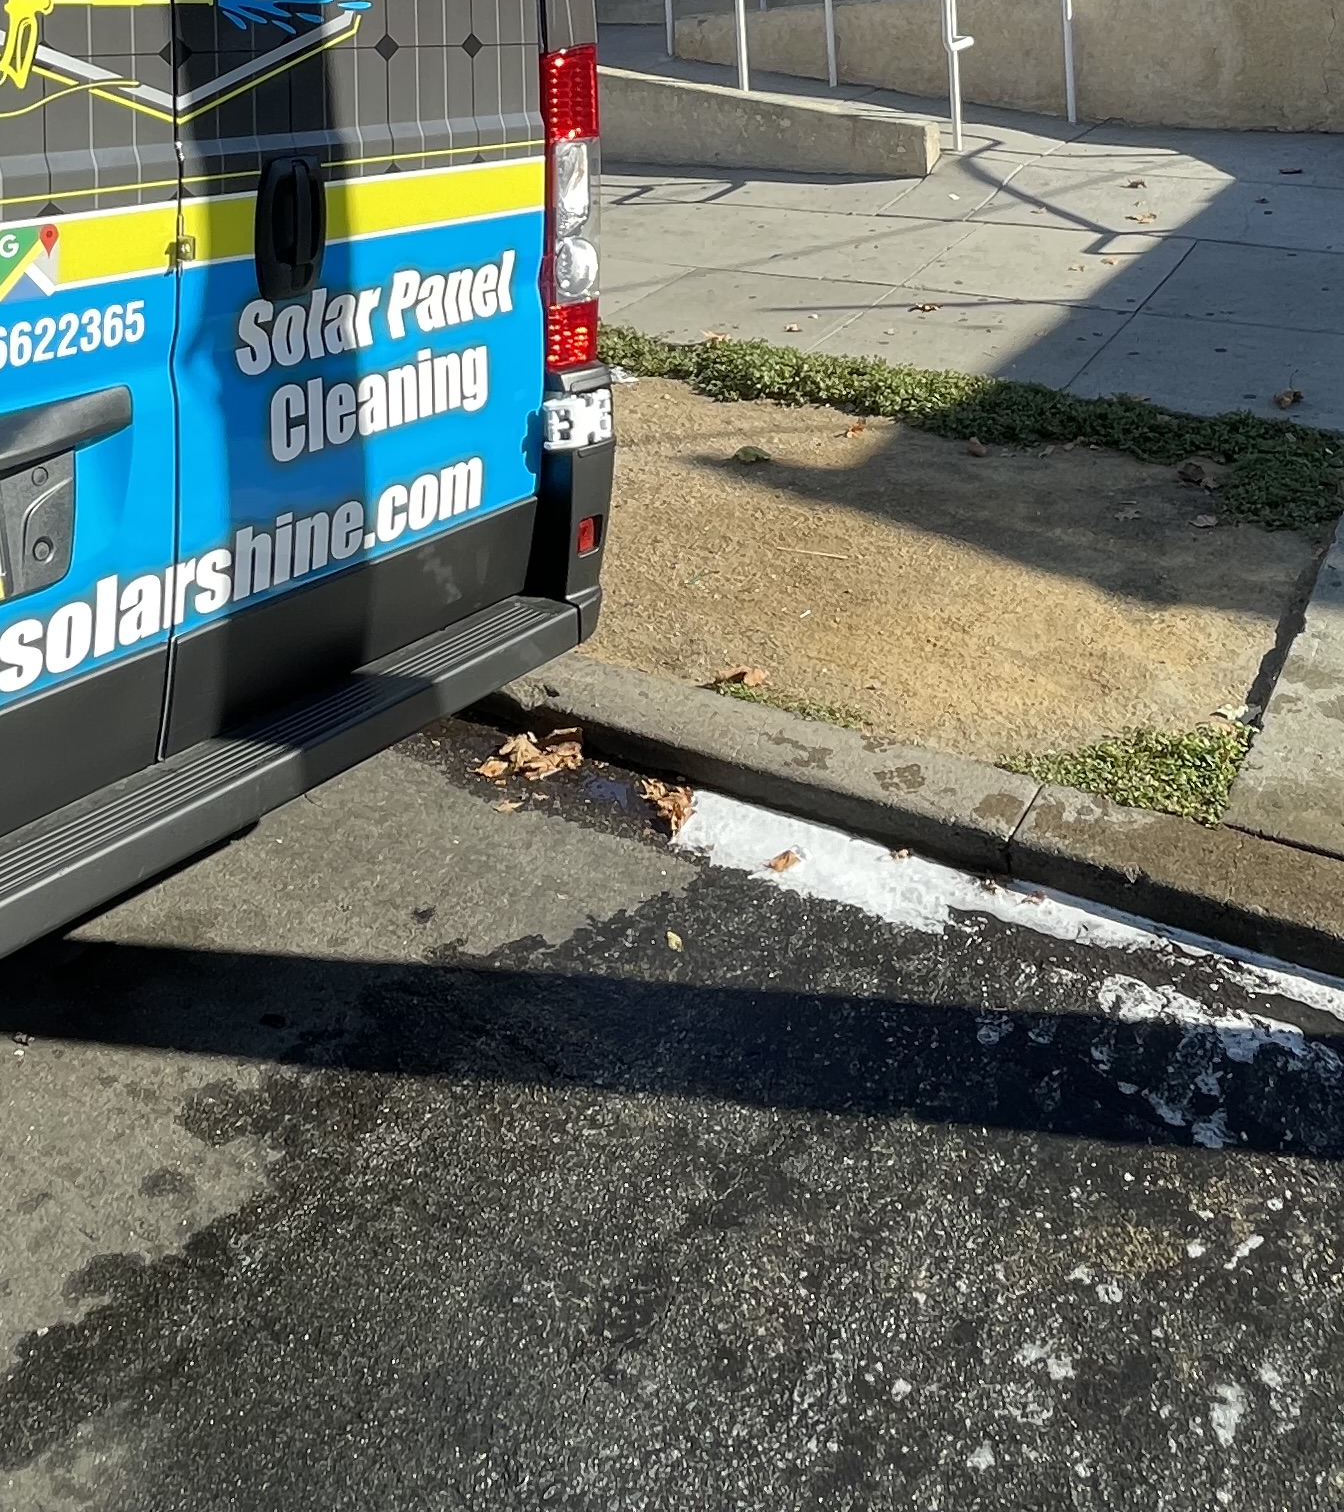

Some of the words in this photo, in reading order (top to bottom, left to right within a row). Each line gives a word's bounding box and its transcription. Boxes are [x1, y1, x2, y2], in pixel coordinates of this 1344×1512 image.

[235, 287, 380, 376] Solar
[388, 250, 516, 340] Panel
[268, 344, 488, 464] Cleaning
